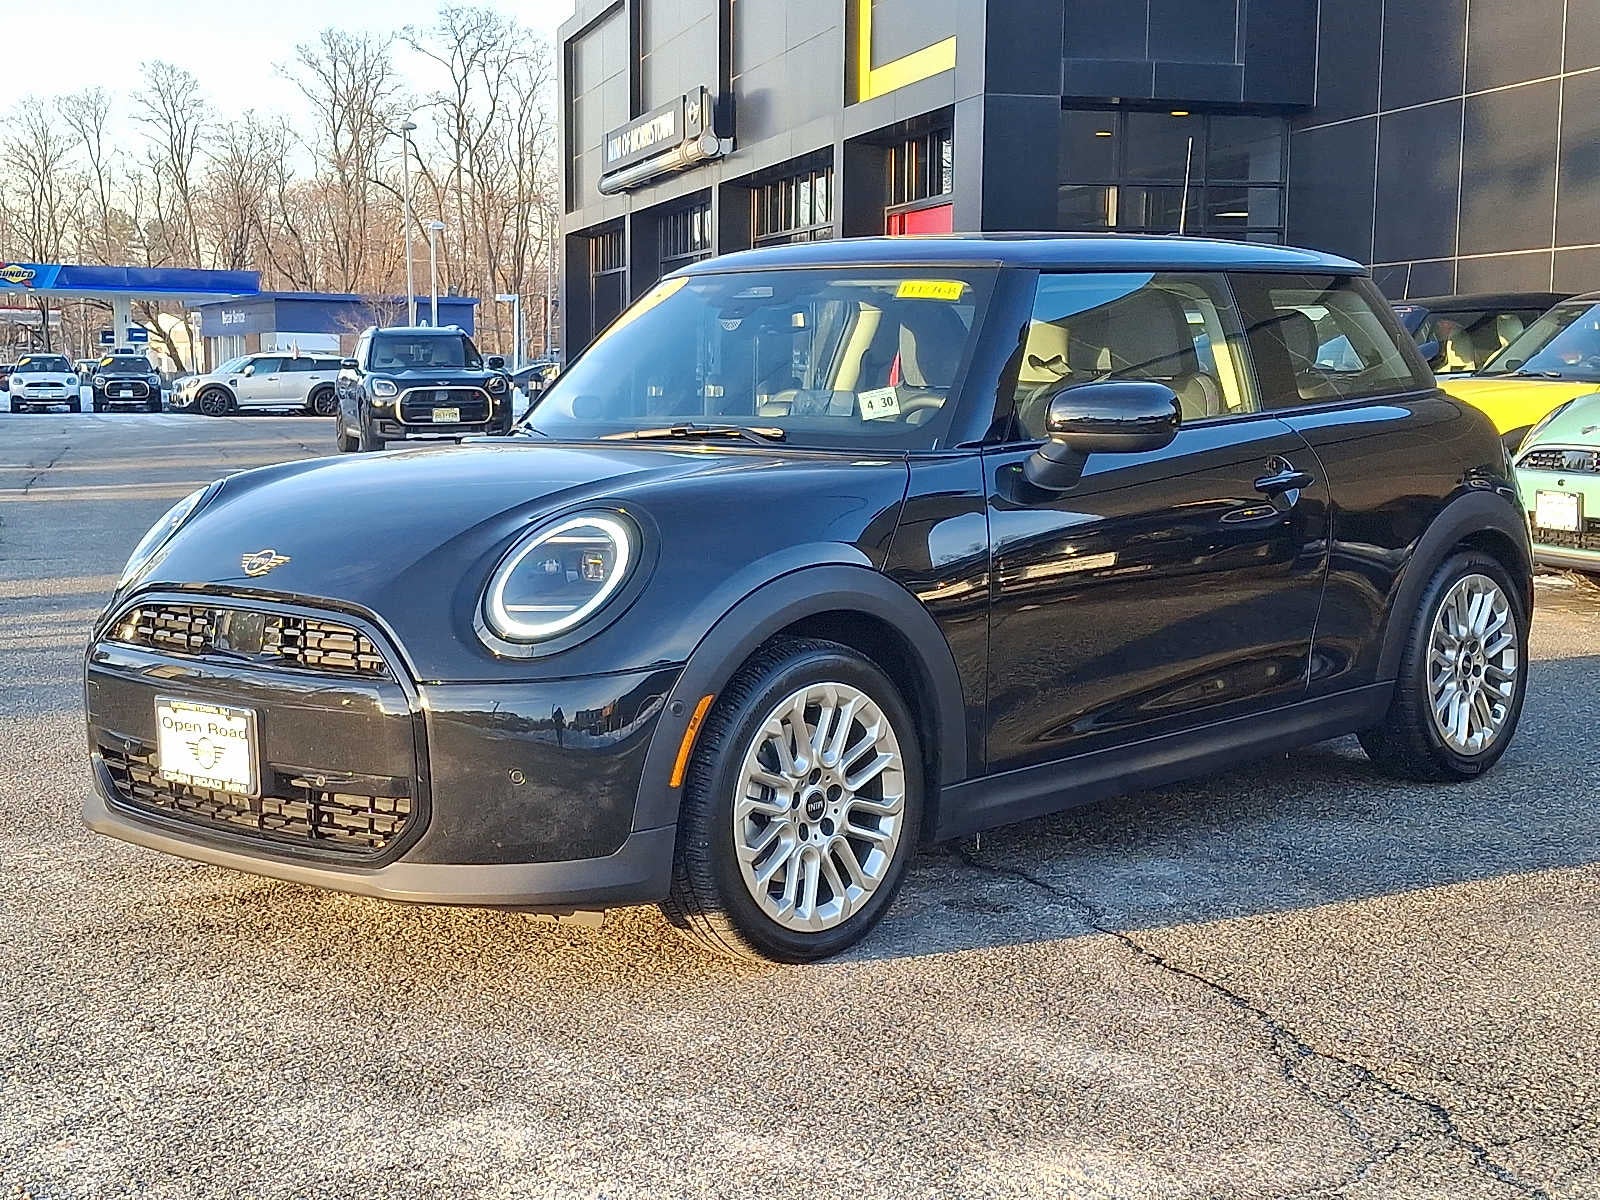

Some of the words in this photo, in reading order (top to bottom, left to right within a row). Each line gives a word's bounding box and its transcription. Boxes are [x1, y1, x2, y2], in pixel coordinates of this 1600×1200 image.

[621, 131, 631, 156] OF
[631, 110, 674, 153] MORRISTOWN
[880, 396, 893, 407] 30
[162, 716, 202, 732] Open
[208, 722, 248, 739] Road
[192, 776, 223, 790] ROAD
